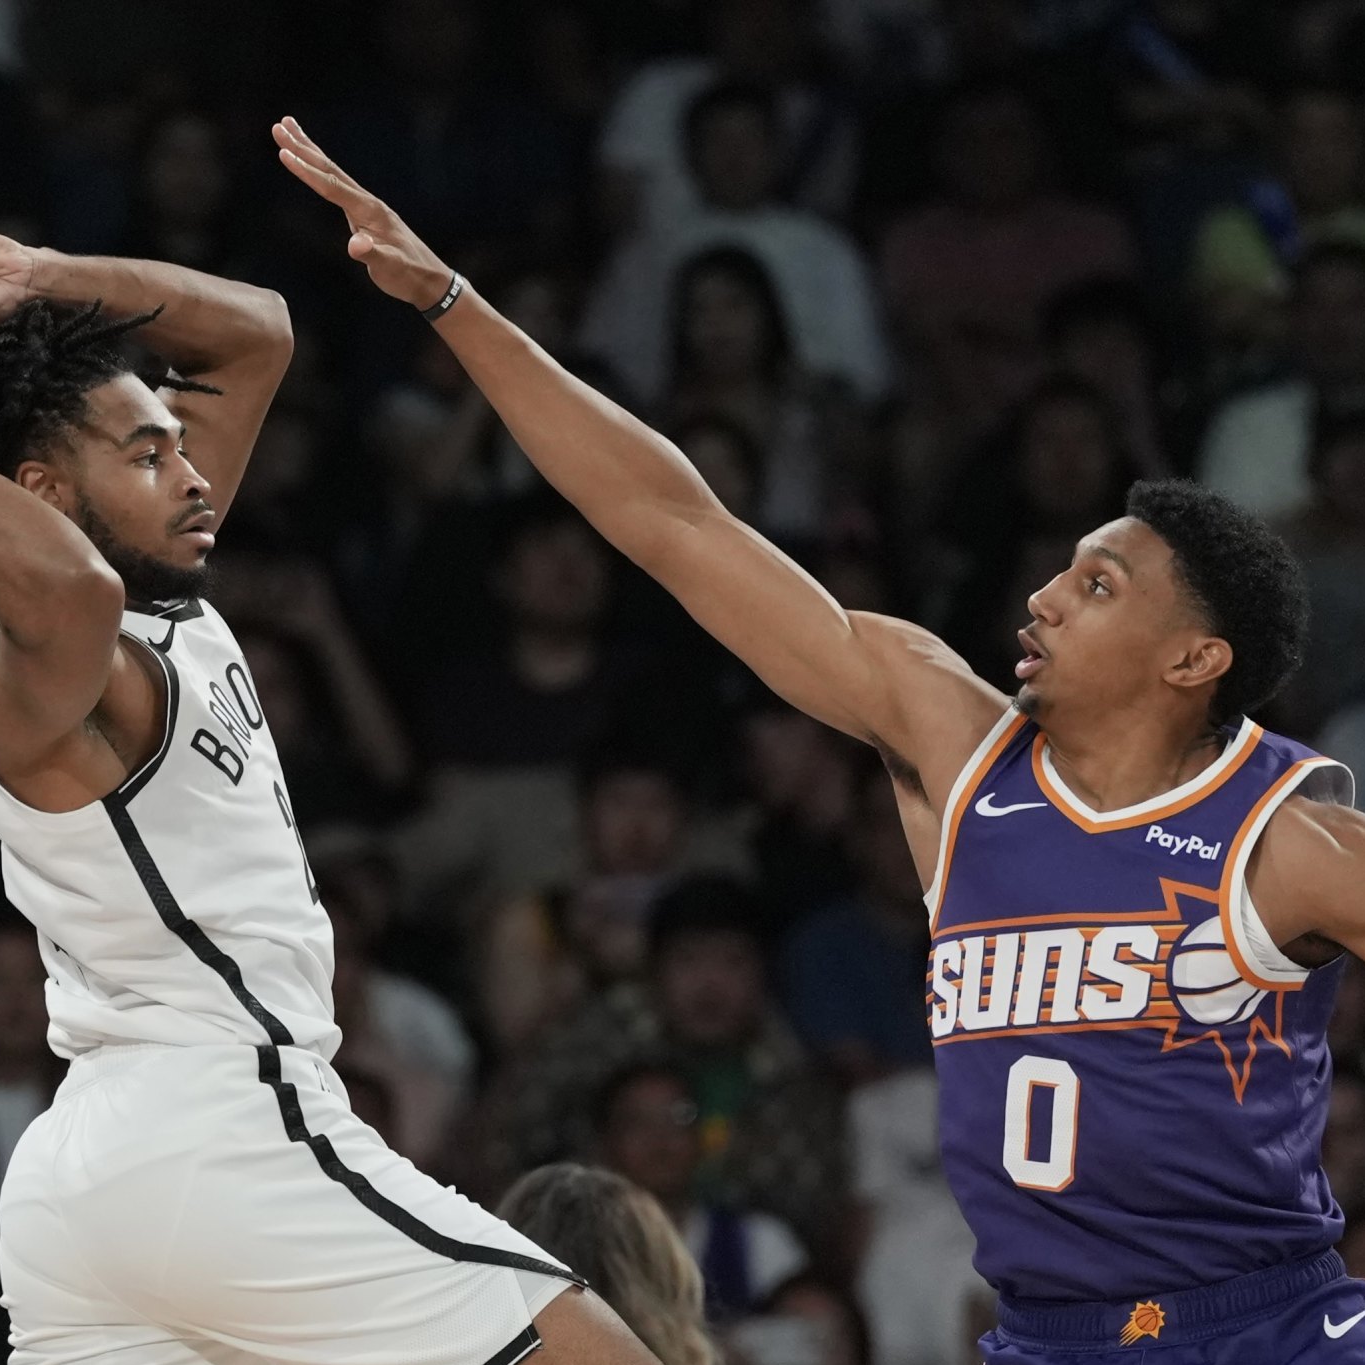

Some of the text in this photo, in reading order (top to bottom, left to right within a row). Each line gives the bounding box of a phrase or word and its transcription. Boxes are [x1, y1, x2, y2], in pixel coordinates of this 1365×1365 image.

[190, 662, 264, 786] BROO
[1145, 824, 1222, 861] PayPal
[931, 925, 1159, 1038] SUNS
[1002, 1054, 1081, 1193] 0
